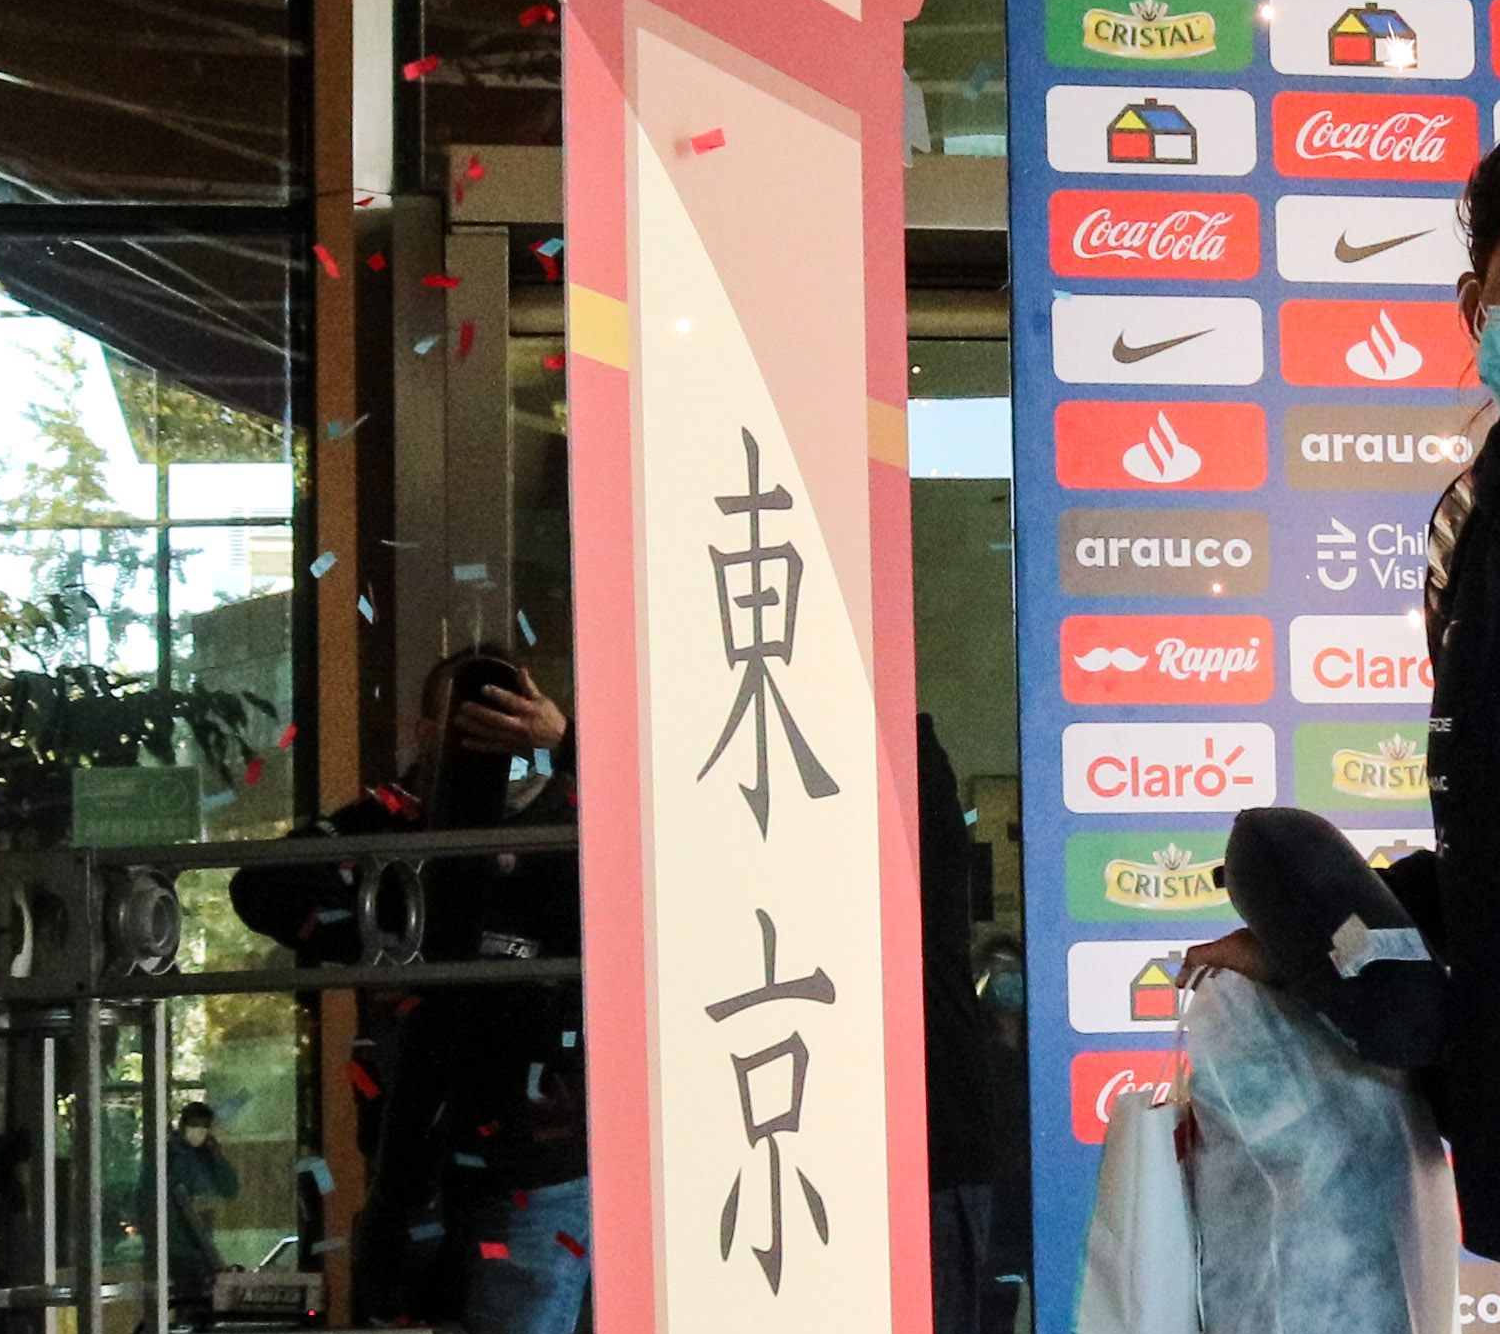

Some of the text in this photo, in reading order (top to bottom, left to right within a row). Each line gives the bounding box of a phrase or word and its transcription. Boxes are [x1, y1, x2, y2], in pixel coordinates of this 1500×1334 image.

[1093, 20, 1203, 48] CRISTAL
[1294, 110, 1454, 163] Coca-Cola
[1071, 208, 1235, 261] Coca-Cola
[1075, 536, 1252, 568] arauco
[1367, 521, 1429, 557] Chil
[1368, 558, 1425, 591] Visi
[1155, 636, 1261, 681] Rappi
[1087, 755, 1226, 797] Claro
[696, 425, 841, 1296] 東京
[1116, 869, 1213, 899] CRISTA
